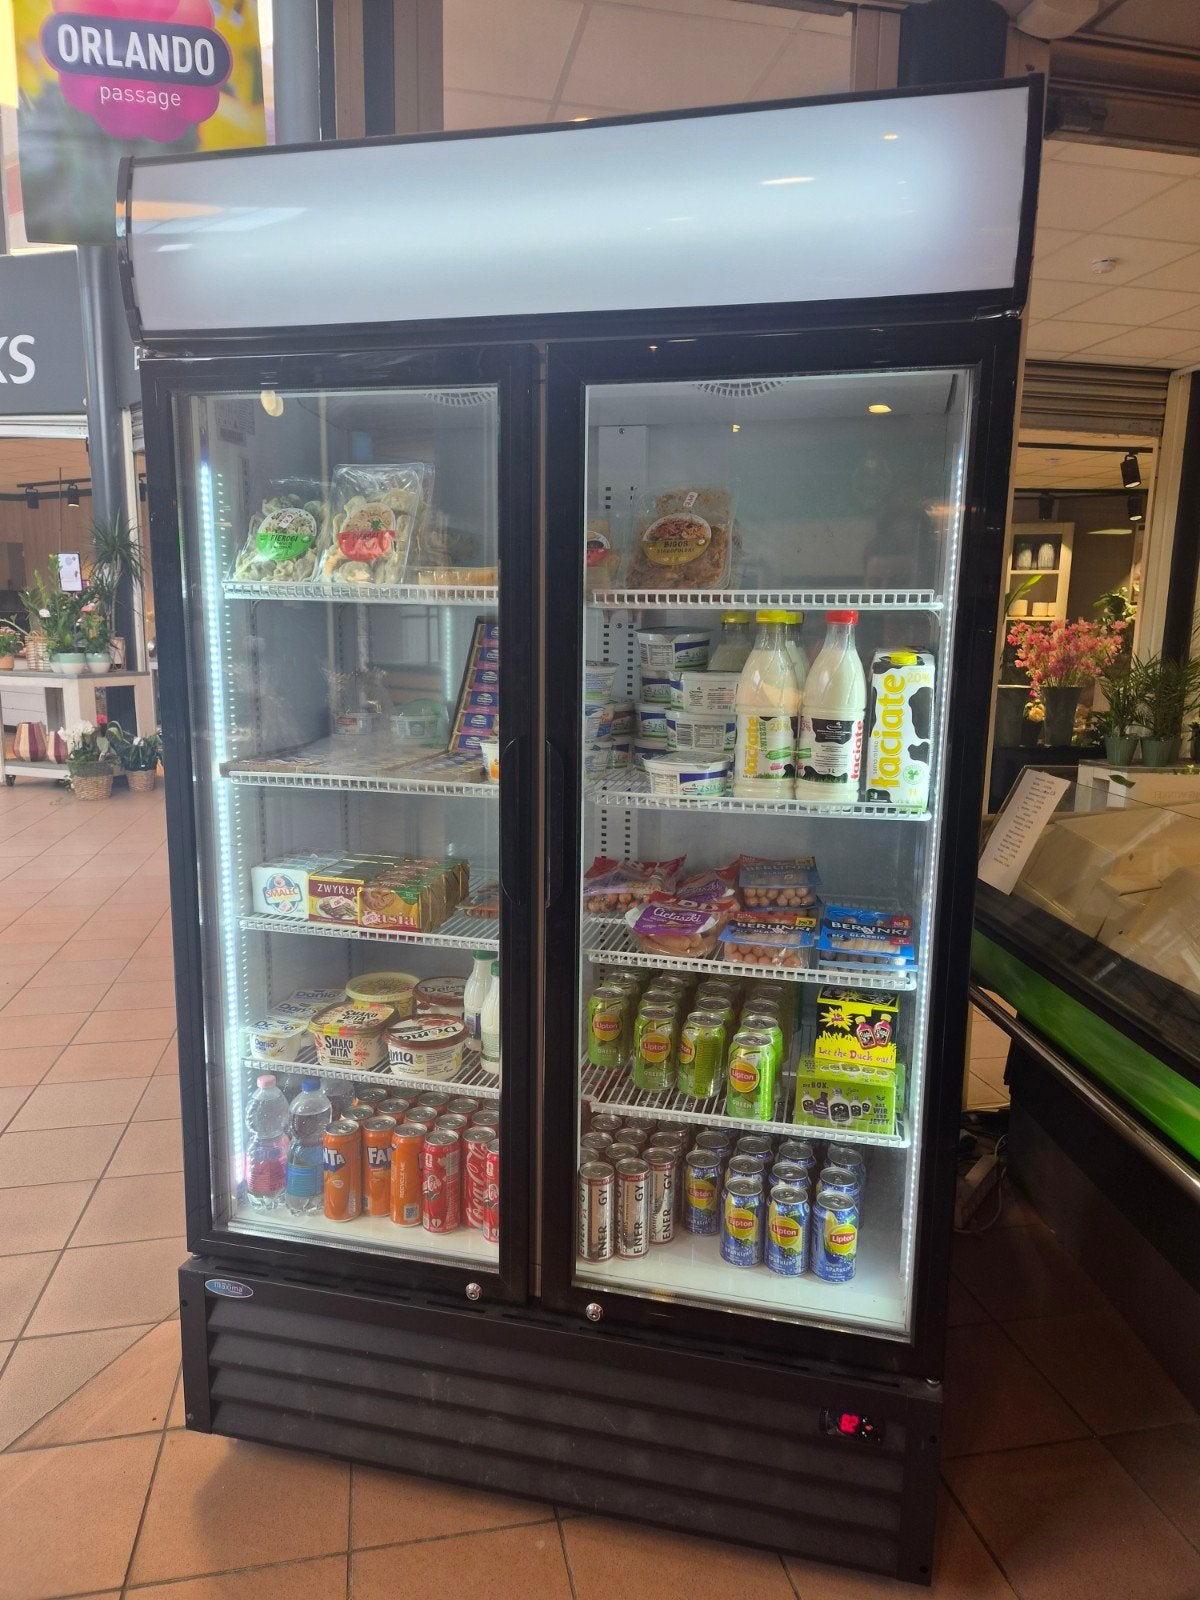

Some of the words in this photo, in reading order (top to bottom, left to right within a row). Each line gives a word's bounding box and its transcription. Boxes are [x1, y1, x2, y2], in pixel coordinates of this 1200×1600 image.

[57, 23, 215, 76] ORLANDO
[99, 85, 182, 110] passage
[265, 886, 299, 899] SMALEC
[317, 883, 357, 896] ZWYKŁA
[595, 1021, 619, 1030] Lipton
[324, 1035, 354, 1054] SMAKO
[643, 1042, 668, 1052] Lipton
[329, 1046, 349, 1058] WITA
[850, 1050, 873, 1062] Duck
[732, 1069, 755, 1081] Lipton
[663, 1174, 672, 1190] GY
[598, 1189, 608, 1206] GY
[634, 1185, 644, 1202] GY
[662, 1208, 671, 1240] ENER
[729, 1217, 753, 1228] Lipton
[633, 1221, 643, 1254] ENER
[772, 1225, 797, 1237] Lipton
[832, 1234, 856, 1244] Lipton
